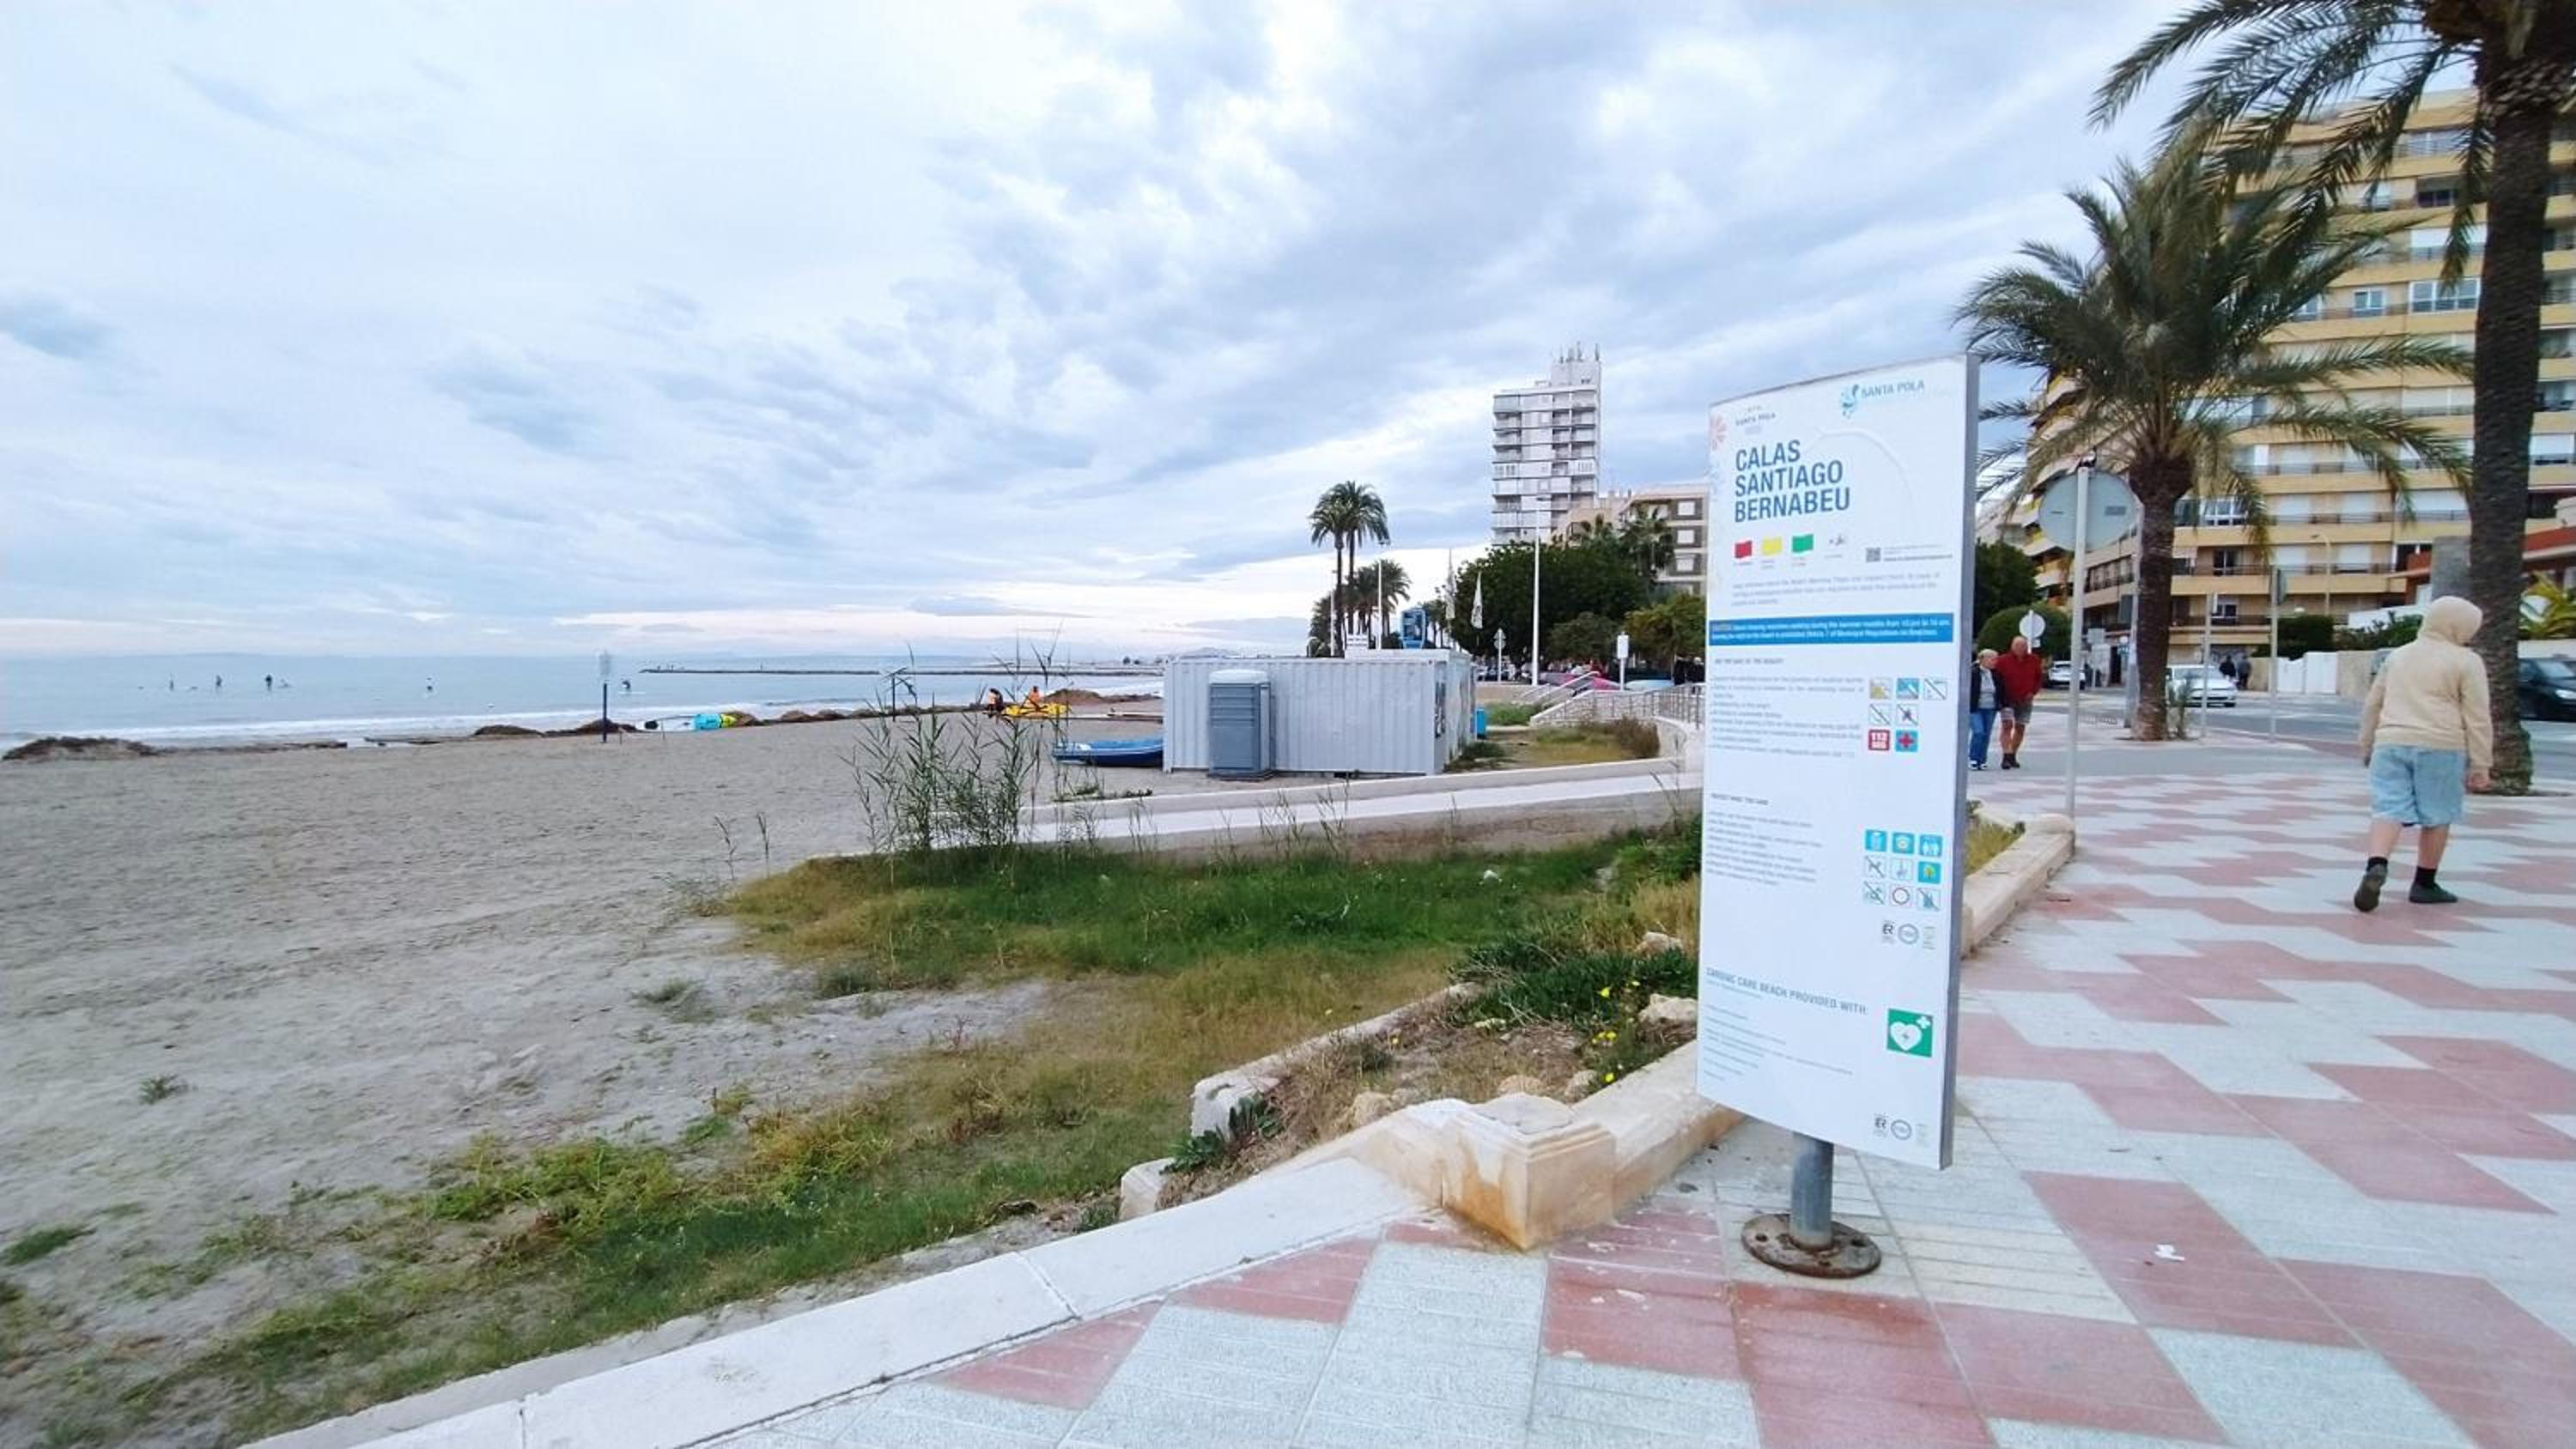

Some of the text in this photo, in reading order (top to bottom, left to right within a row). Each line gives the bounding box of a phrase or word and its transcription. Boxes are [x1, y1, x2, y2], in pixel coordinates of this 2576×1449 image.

[1735, 439, 1801, 471] CALAS
[1735, 459, 1843, 497] SANTIAGO
[1735, 487, 1850, 523] BERNABEU
[1789, 990, 1838, 1009] PROVIDED
